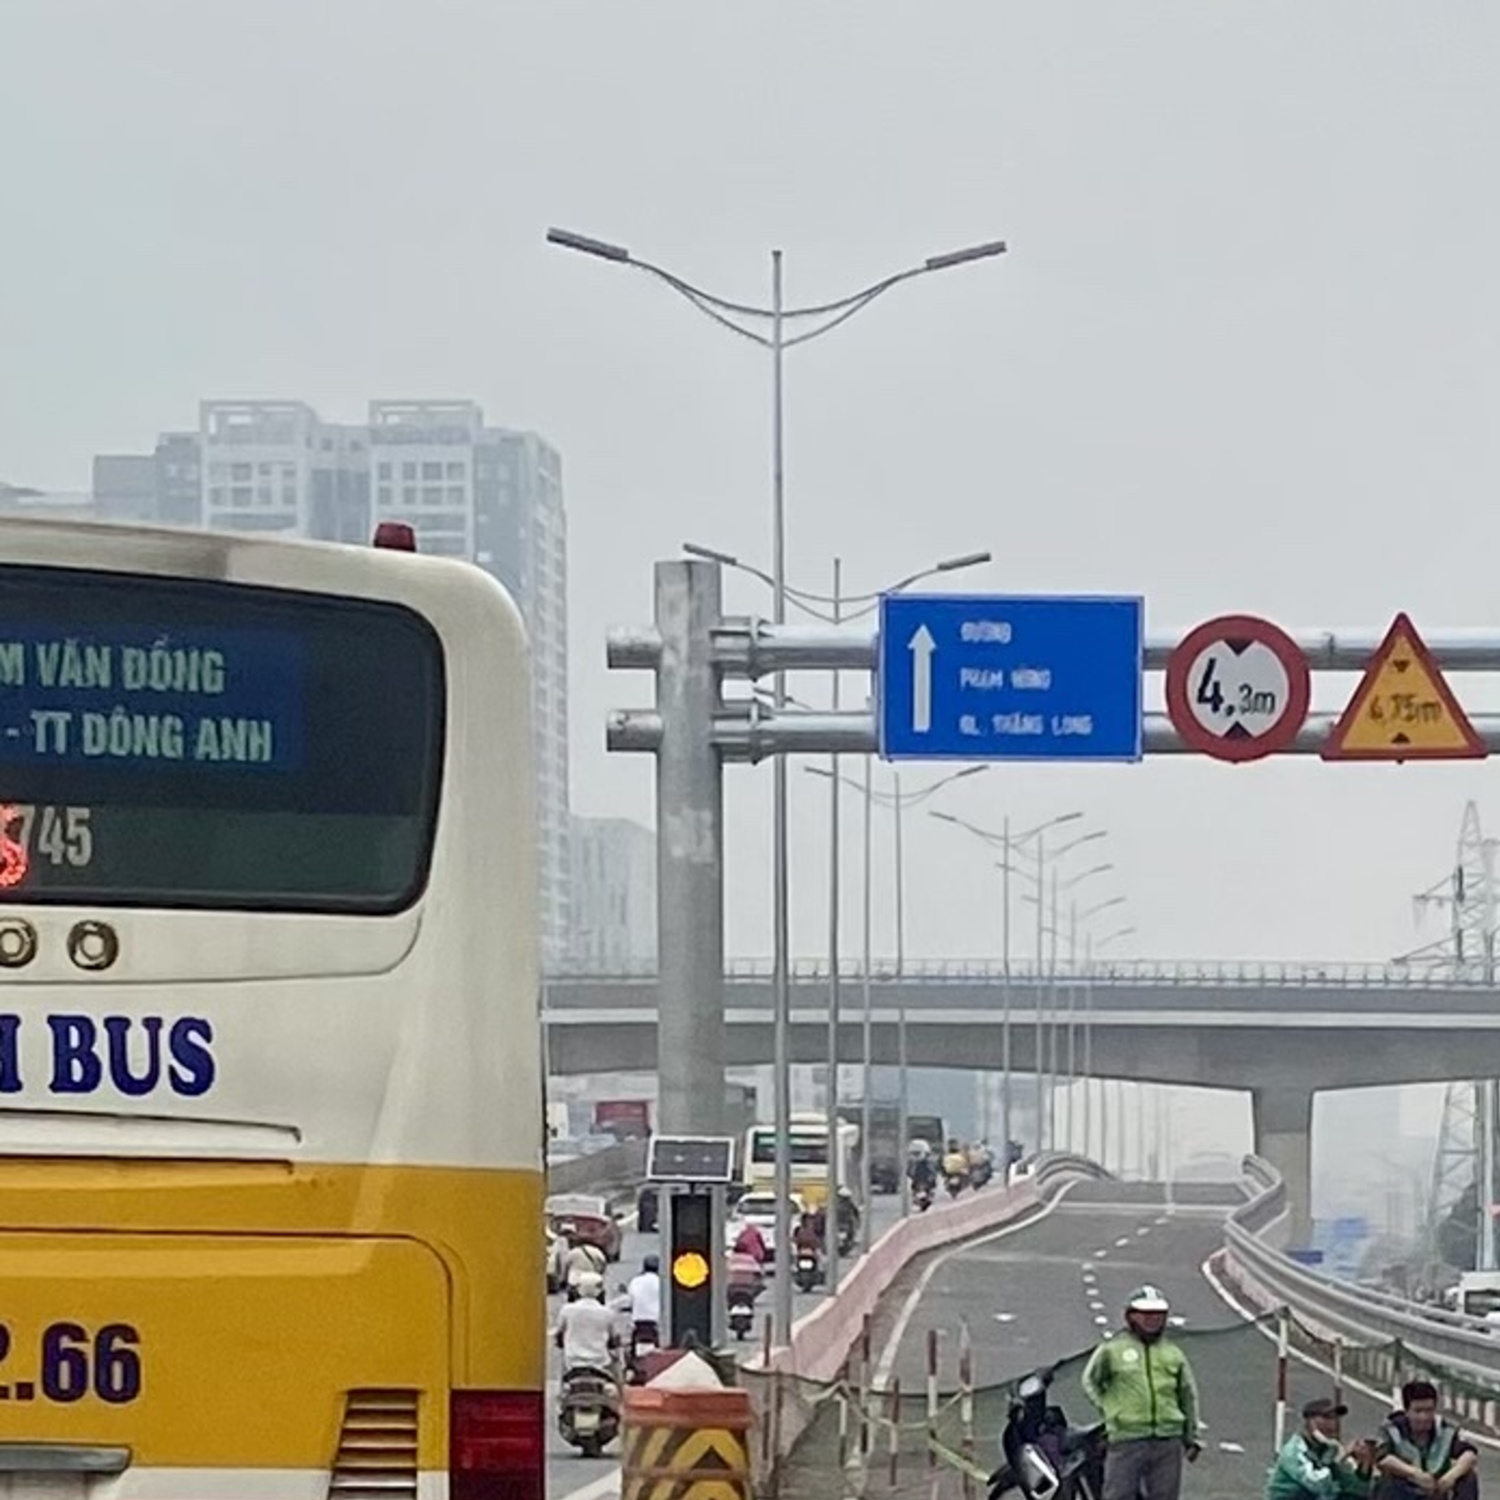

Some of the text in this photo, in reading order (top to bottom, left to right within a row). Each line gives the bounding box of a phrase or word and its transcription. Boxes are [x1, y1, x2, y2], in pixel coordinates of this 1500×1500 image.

[36, 637, 112, 688] VĂN
[30, 709, 72, 754] TT
[194, 717, 273, 763] ANH
[47, 1014, 215, 1096] BUS
